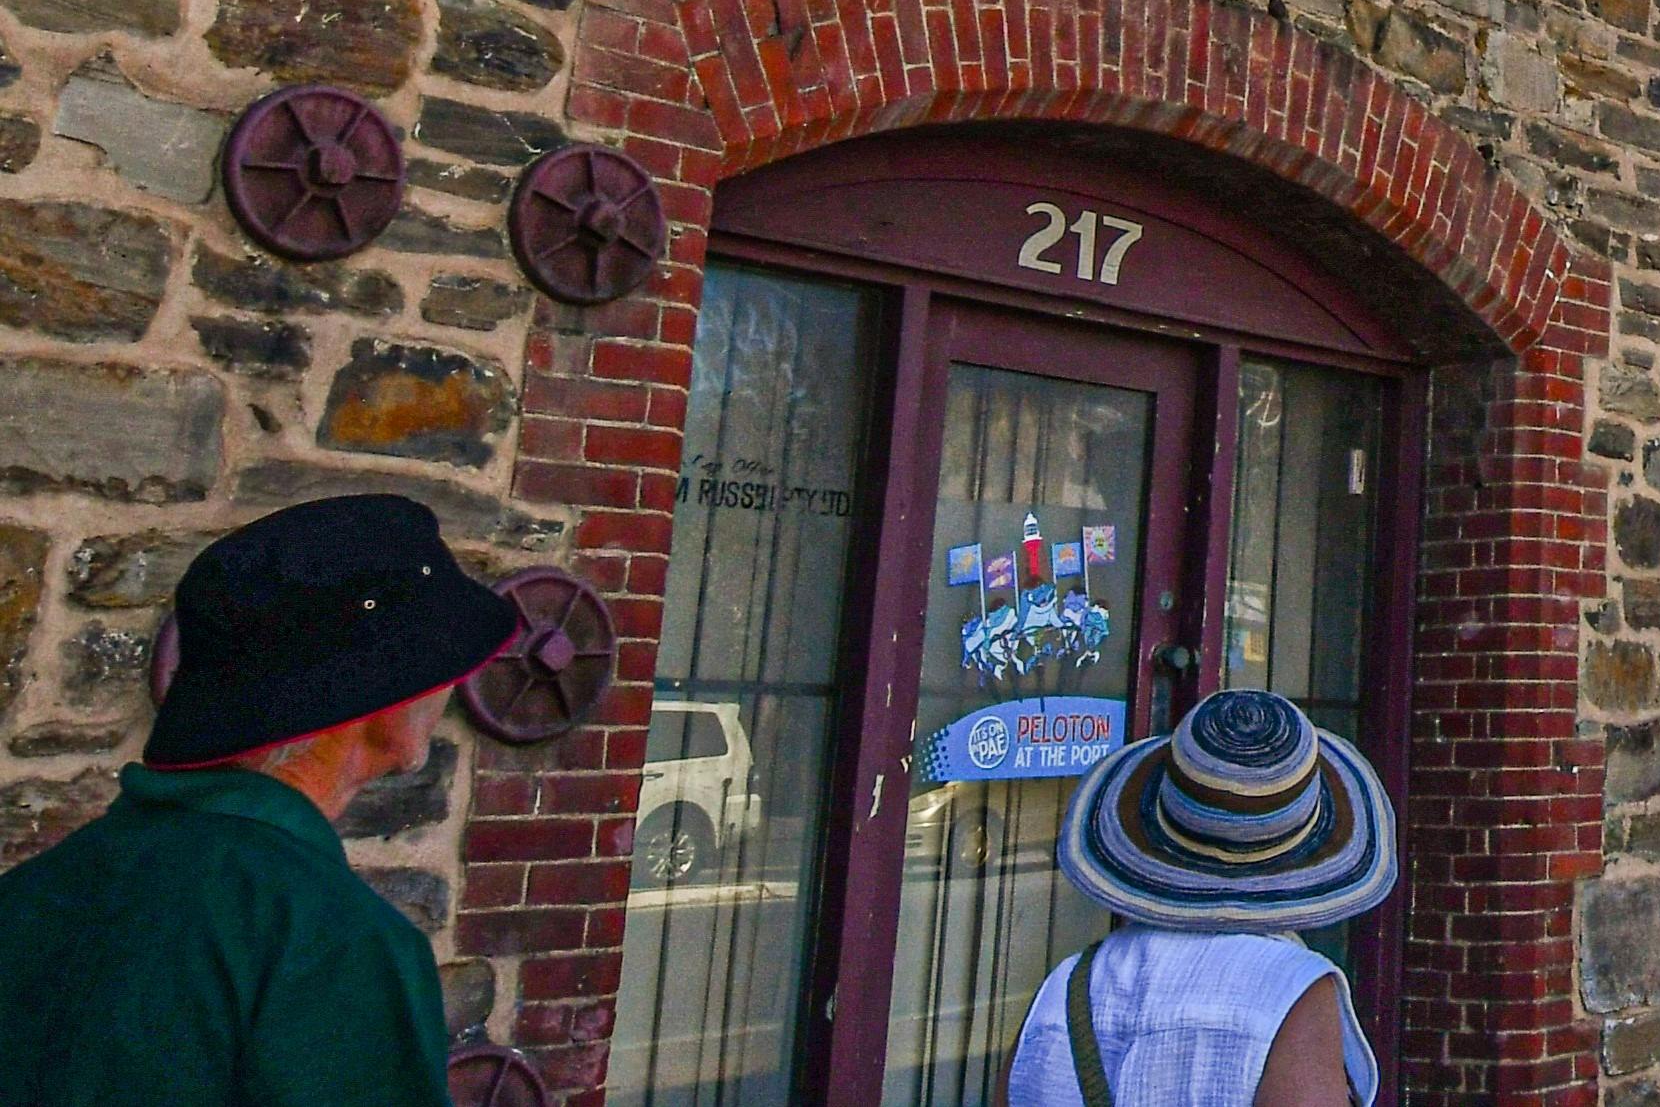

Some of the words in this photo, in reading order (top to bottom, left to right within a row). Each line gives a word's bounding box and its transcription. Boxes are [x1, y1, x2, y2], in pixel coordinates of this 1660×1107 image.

[1017, 201, 1143, 285] 217
[1016, 714, 1110, 744] PELOTON
[978, 733, 1007, 763] PAE
[1014, 746, 1034, 768] AT
[1040, 745, 1067, 767] THE
